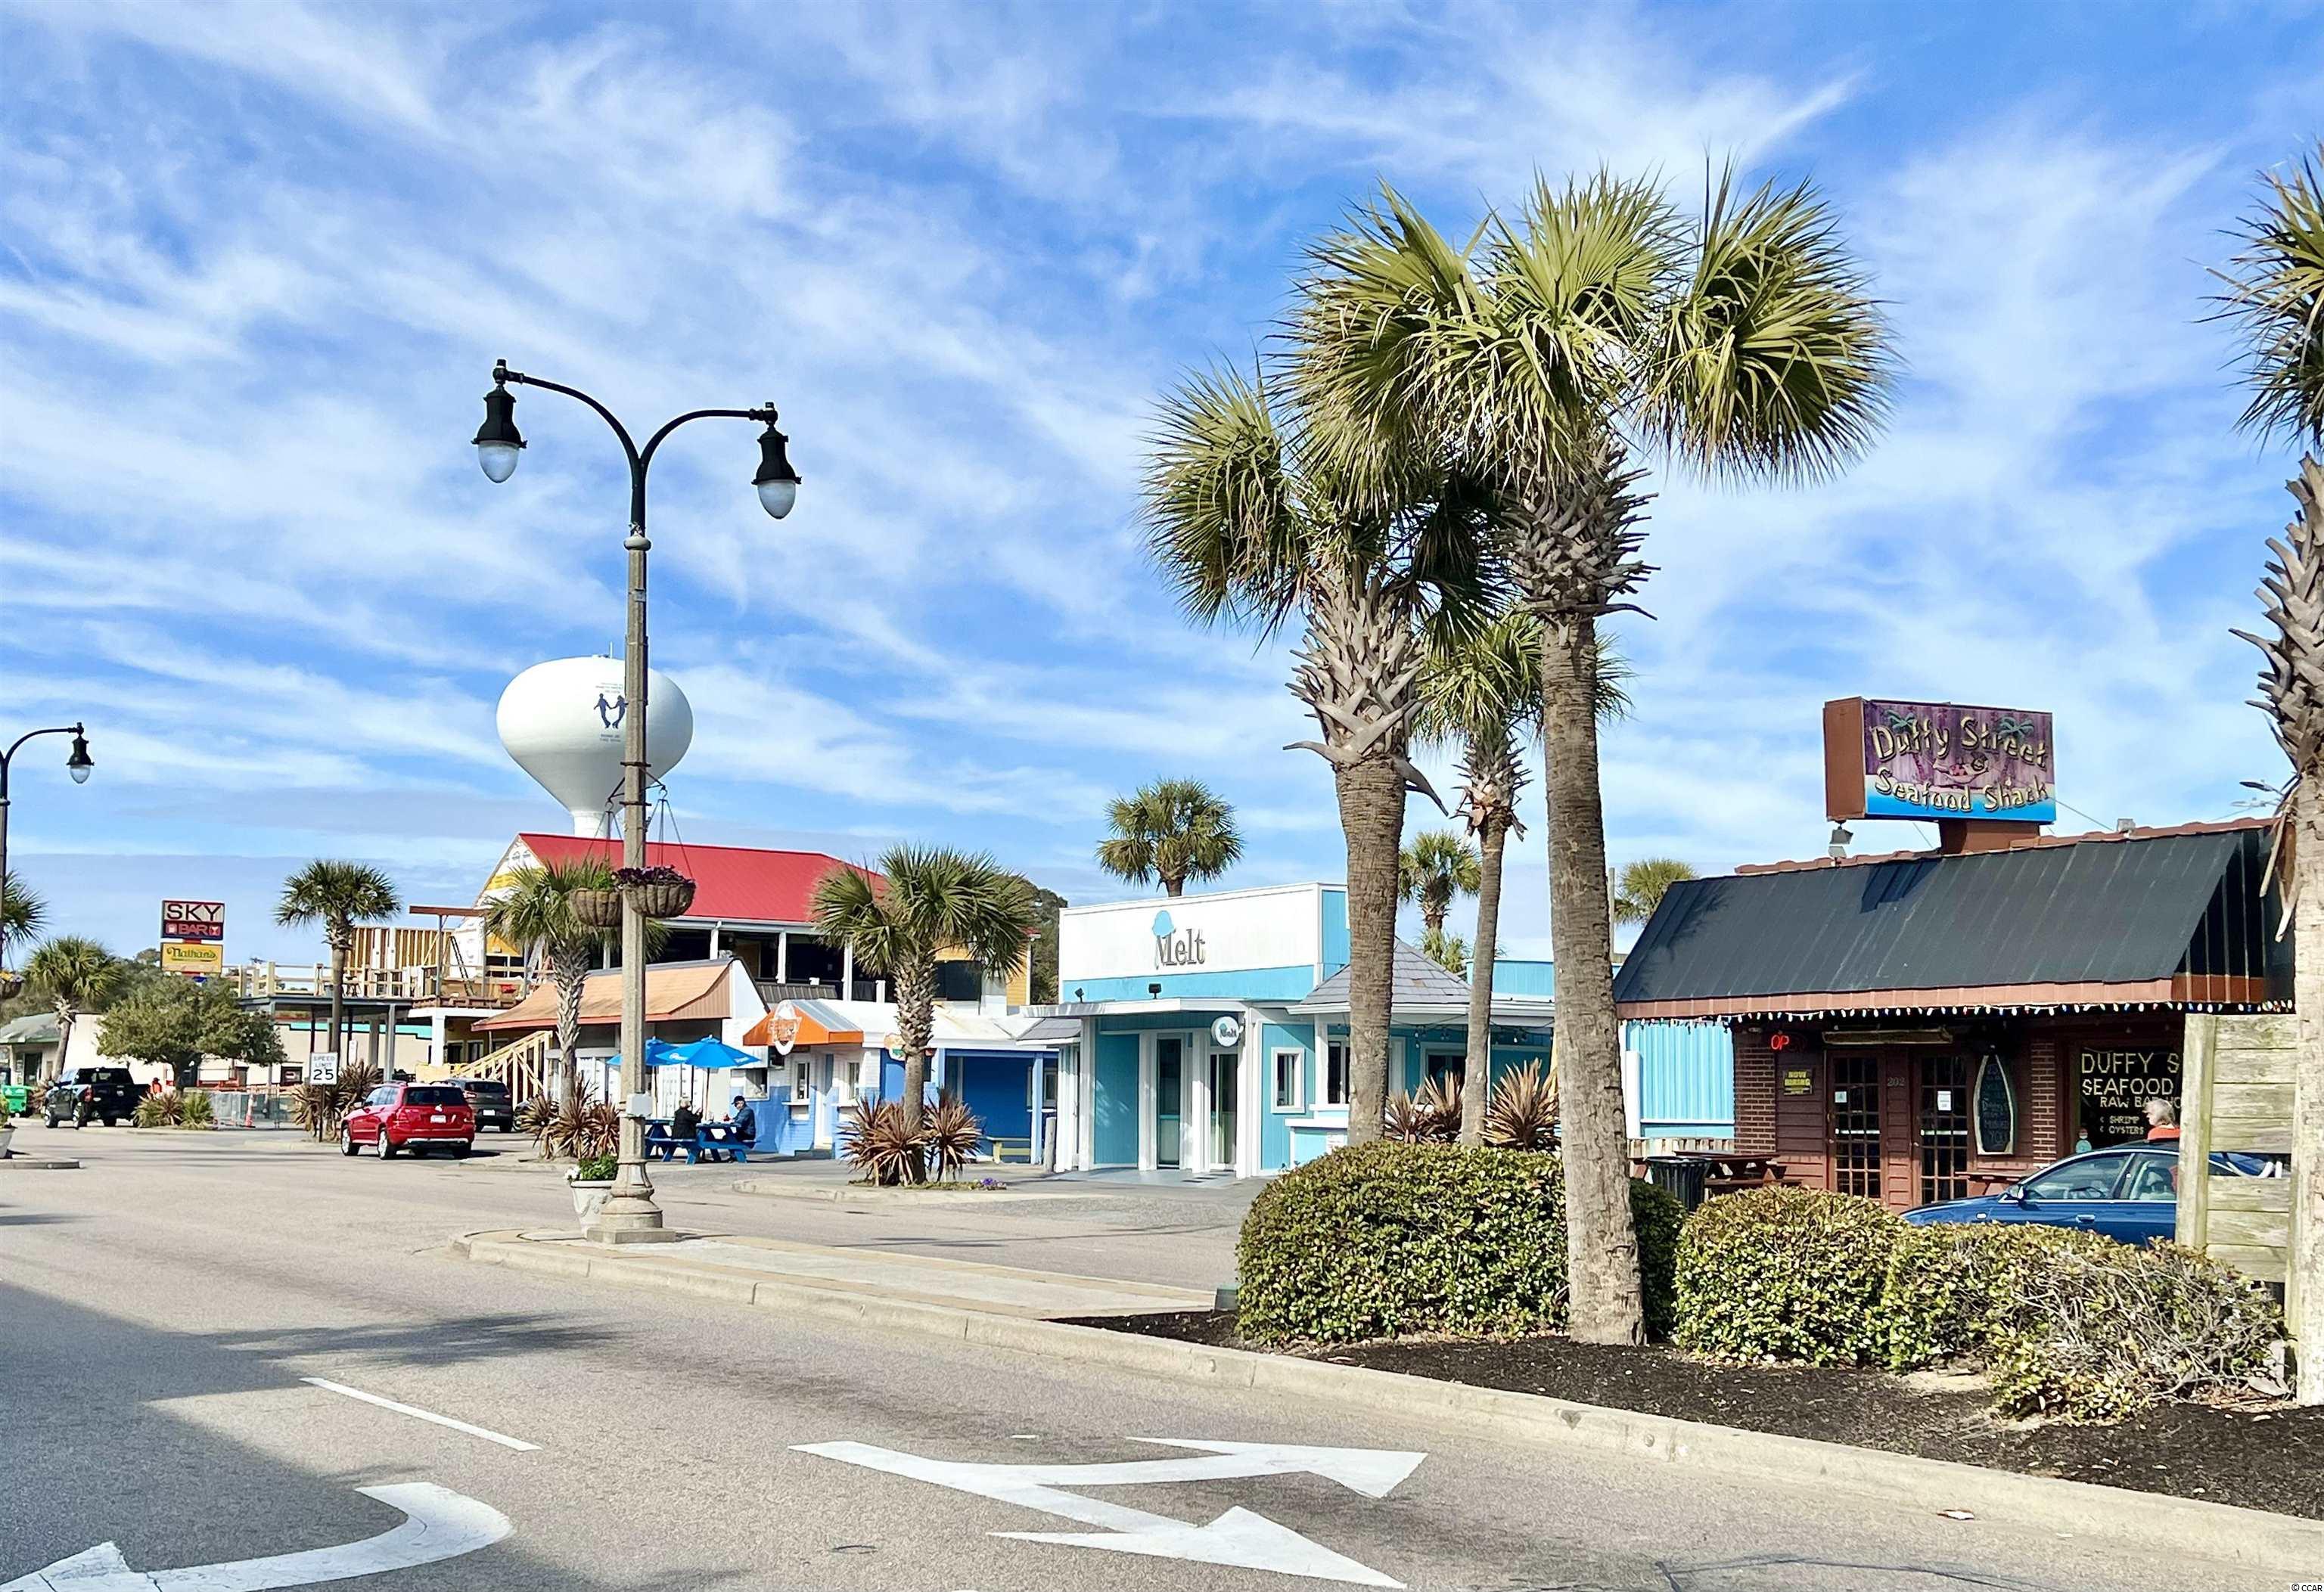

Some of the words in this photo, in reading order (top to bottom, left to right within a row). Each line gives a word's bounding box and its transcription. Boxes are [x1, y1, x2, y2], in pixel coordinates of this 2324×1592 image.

[1869, 718, 1950, 760] Duffy
[1960, 717, 2046, 771] Street
[1875, 766, 1972, 812] Seafood
[1983, 775, 2049, 812] Shack
[166, 903, 222, 922] SKY
[178, 923, 209, 936] BAR
[1154, 928, 1206, 970] Melt
[2081, 1052, 2155, 1074] DUFFY
[313, 1069, 334, 1080] 25
[1887, 1077, 1905, 1087] 202
[2082, 1078, 2174, 1096] SEAFOOD
[2100, 1097, 2129, 1108] RAW
[2109, 1116, 2140, 1124] SHRIMP
[2108, 1125, 2145, 1134] OYSTERS
